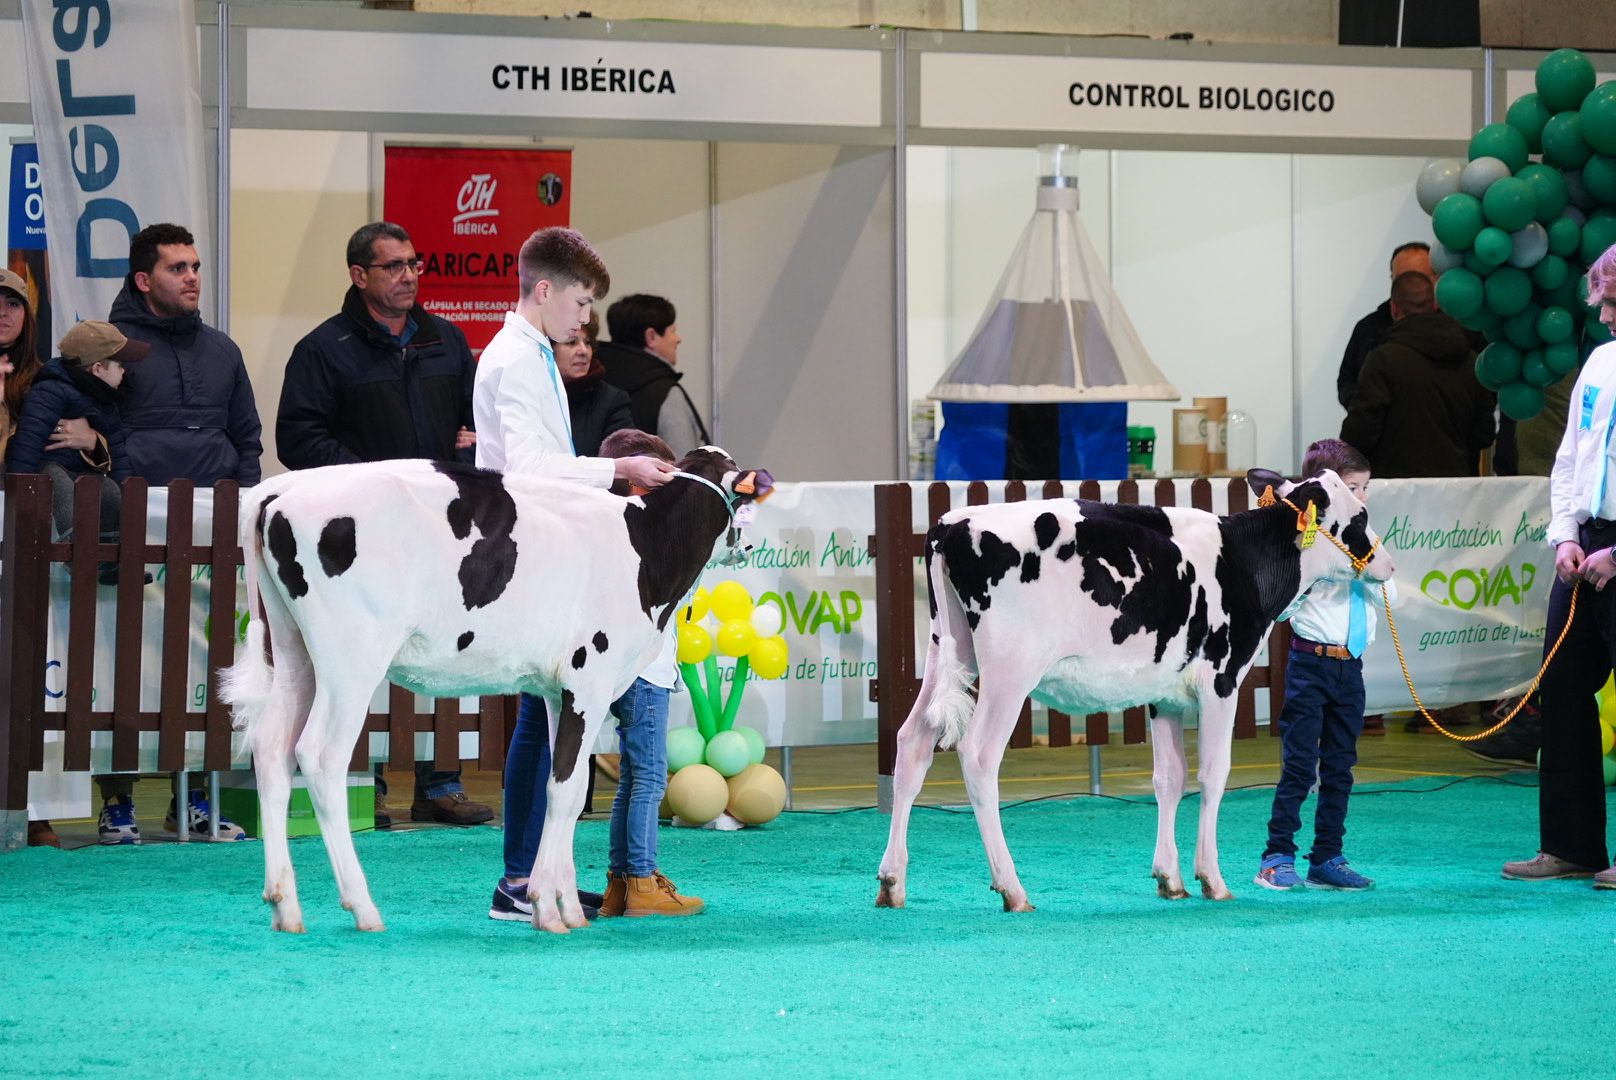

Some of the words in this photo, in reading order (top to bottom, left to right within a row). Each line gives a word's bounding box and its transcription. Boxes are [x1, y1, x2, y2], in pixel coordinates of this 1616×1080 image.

[492, 65, 550, 90] CTH
[561, 58, 676, 94] IBÉRICA
[1069, 83, 1190, 109] CONTROL
[1199, 88, 1335, 112] BIOLOGICO
[457, 173, 498, 212] CTH
[453, 220, 498, 235] IBÉRICA
[423, 299, 462, 311] CÁPSULA
[462, 301, 473, 311] DE
[474, 301, 509, 311] SECADO
[1383, 515, 1503, 551] Alimentación
[1420, 562, 1536, 611] COVAP
[751, 590, 863, 635] OVAP
[1419, 623, 1486, 651] garantía
[1491, 621, 1513, 642] de
[795, 658, 817, 680] de
[821, 657, 877, 685] futuro
